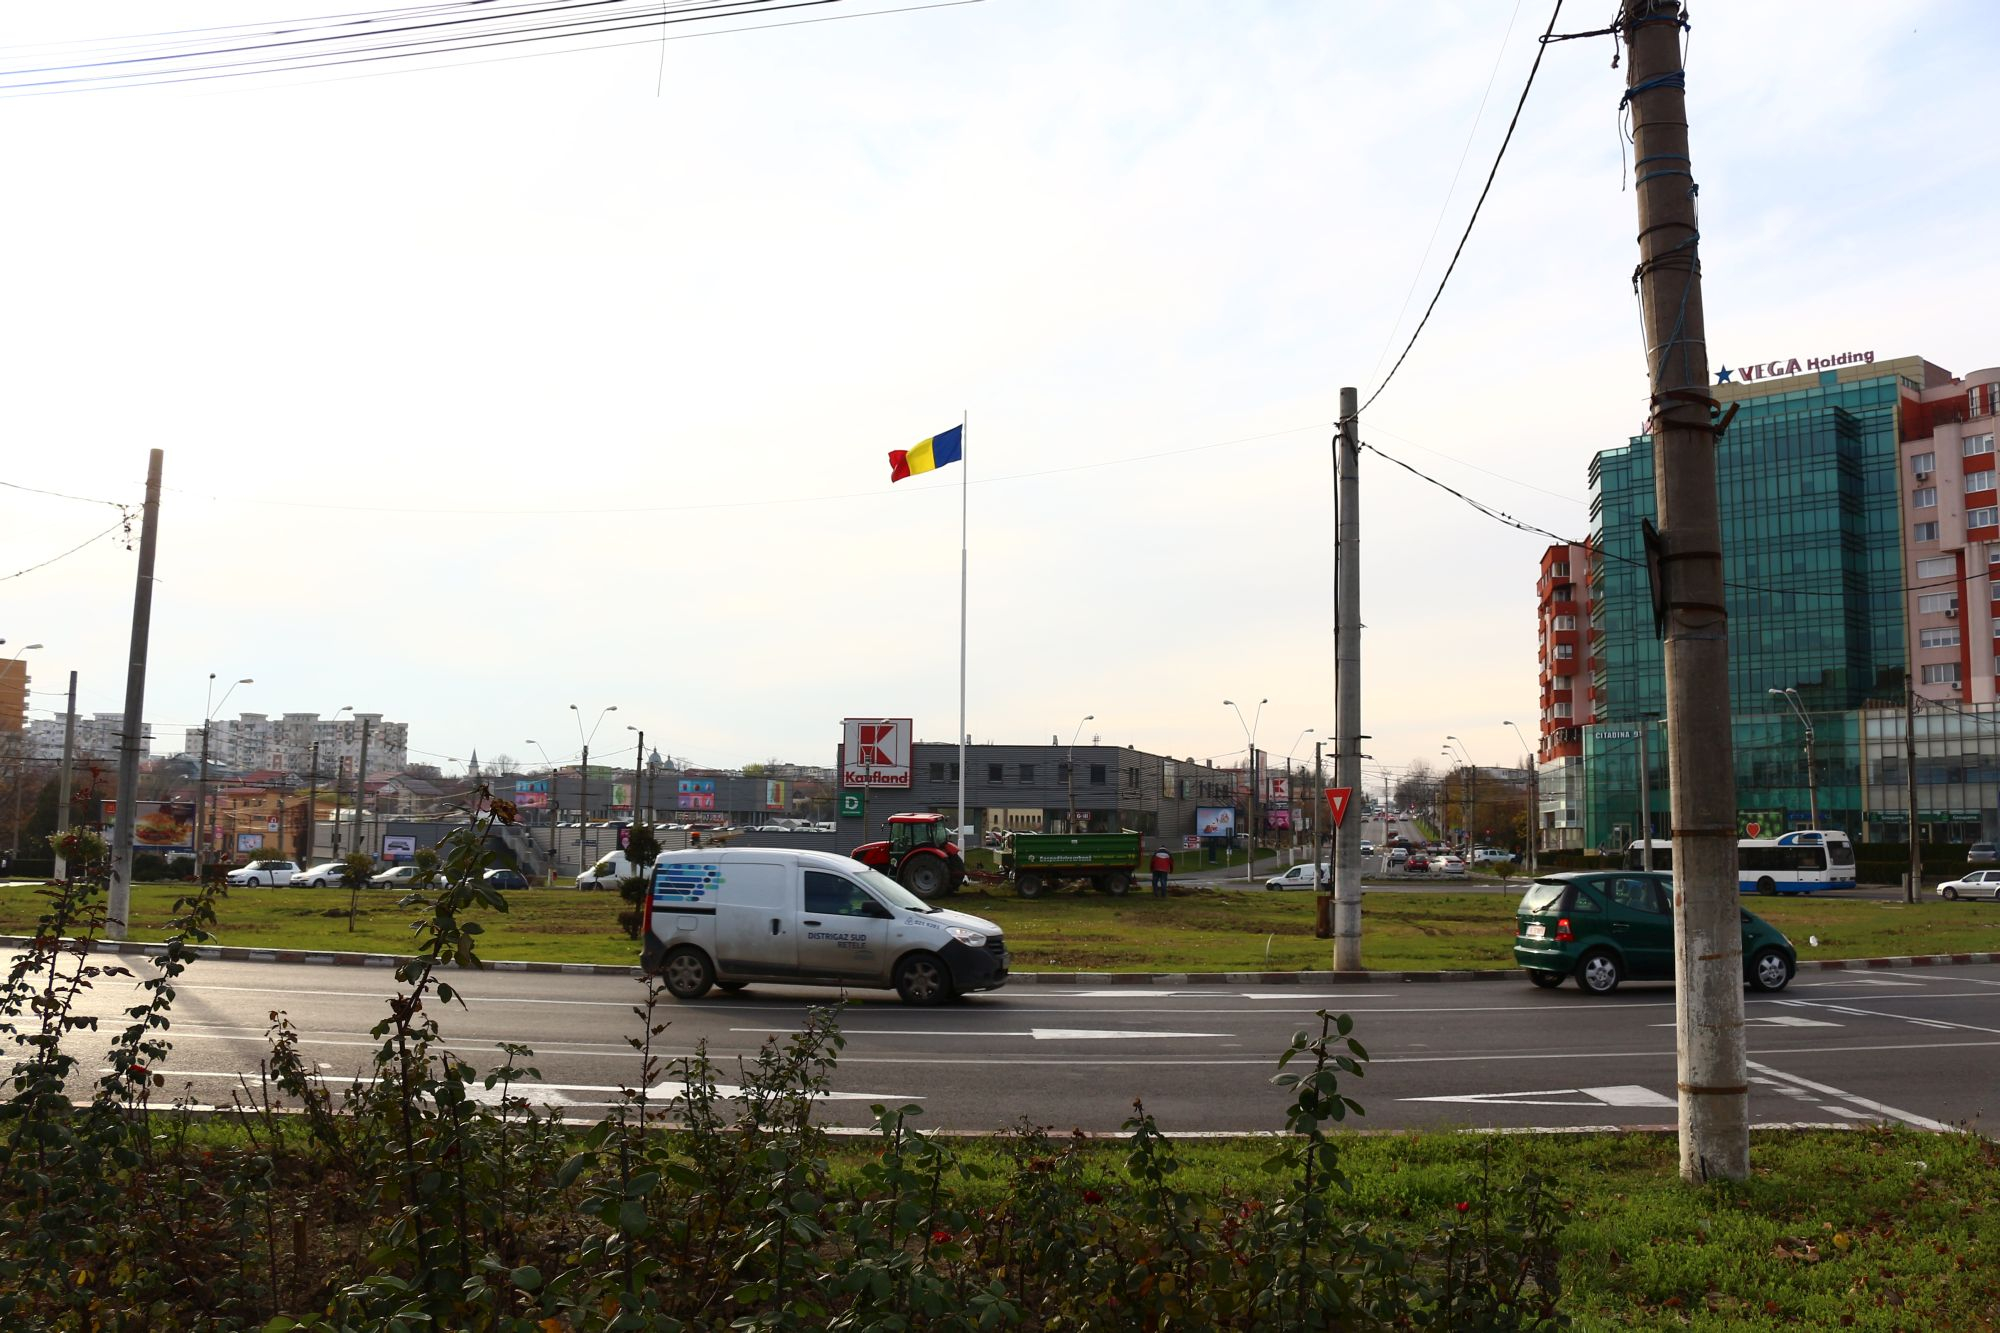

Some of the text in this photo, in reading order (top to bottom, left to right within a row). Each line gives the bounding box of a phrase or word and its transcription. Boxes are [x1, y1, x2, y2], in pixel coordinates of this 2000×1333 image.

[1738, 350, 1875, 382] VEGA Holding
[1595, 731, 1630, 739] CITADINA
[808, 932, 867, 942] DISTRIGAZ SUD
